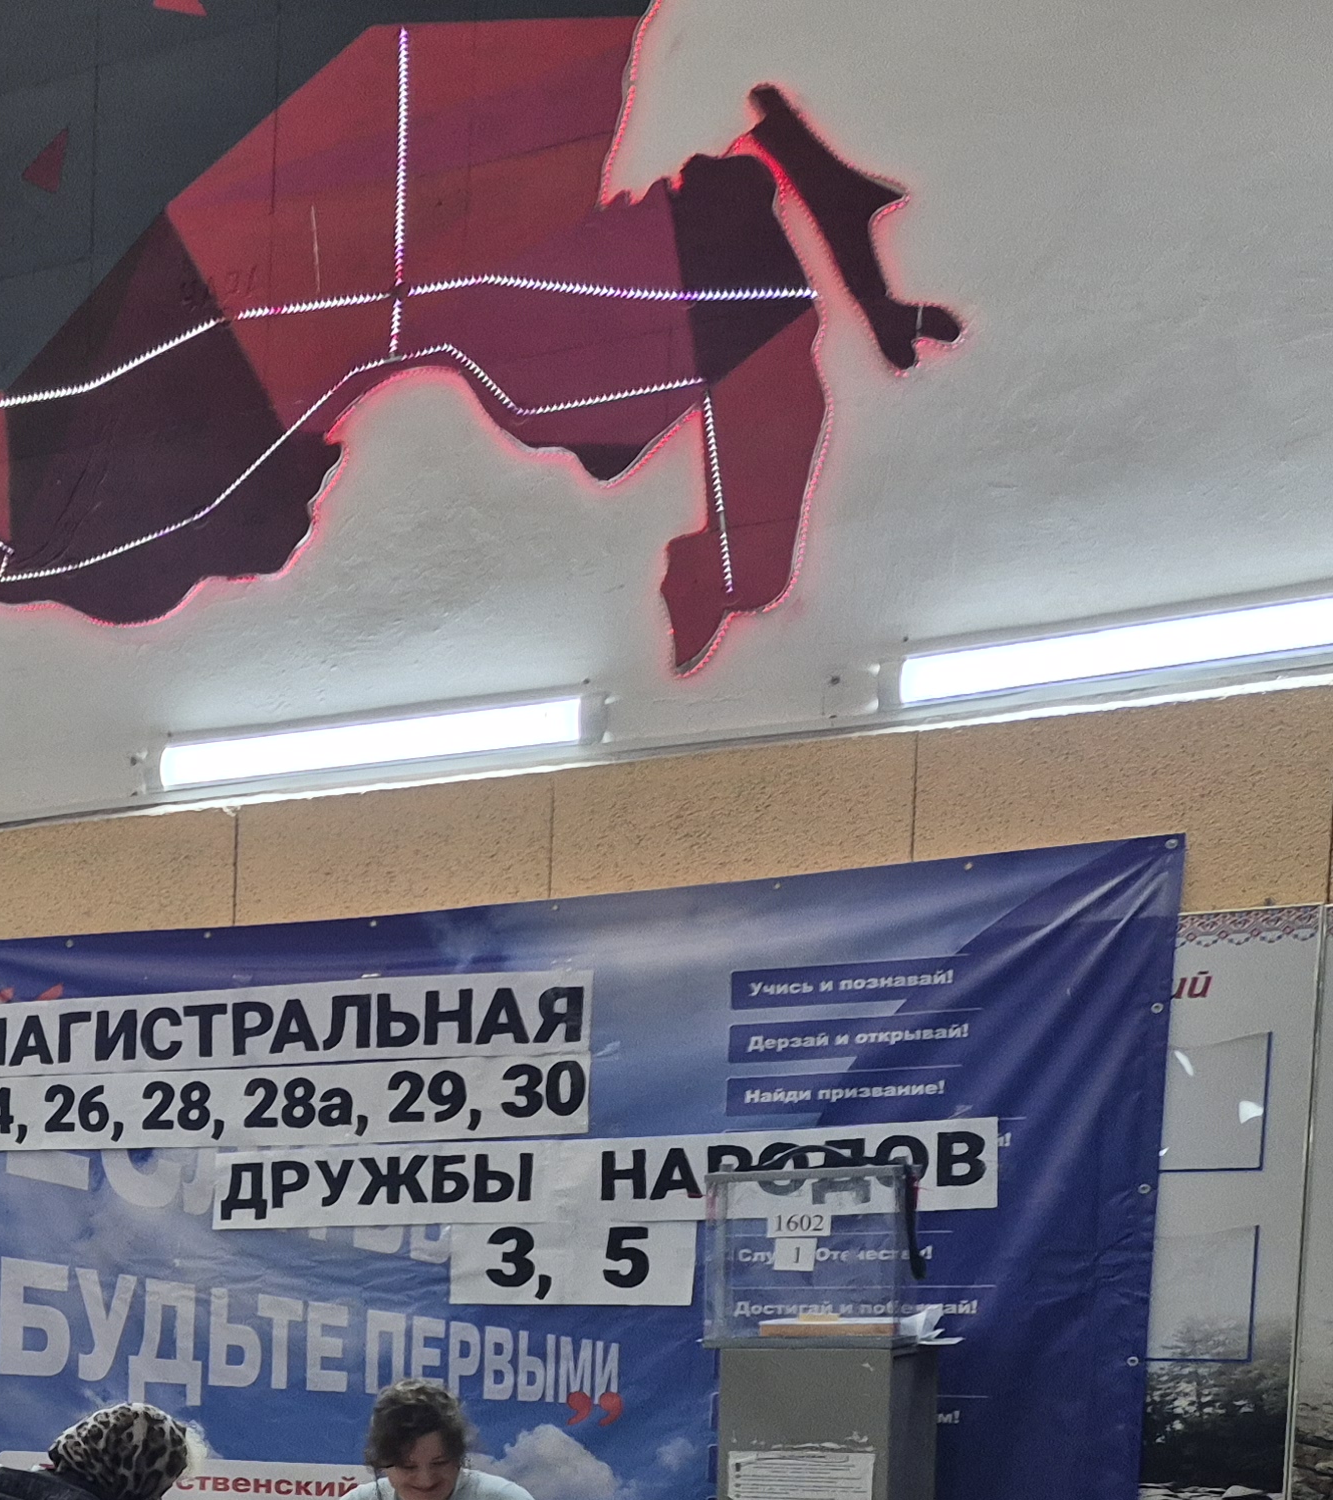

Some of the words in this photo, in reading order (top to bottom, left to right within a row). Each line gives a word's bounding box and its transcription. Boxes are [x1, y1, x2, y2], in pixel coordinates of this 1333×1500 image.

[749, 981, 813, 997] Учись
[820, 980, 833, 992] и
[839, 969, 954, 990] познавай!
[747, 1032, 829, 1052] Дерзай
[835, 1034, 848, 1046] и
[855, 1023, 970, 1045] открывай!
[44, 1084, 124, 1142] 26,
[142, 1081, 225, 1140] 28,
[244, 1077, 368, 1136] 28а,
[387, 1070, 481, 1131] 29,
[501, 1060, 586, 1118] 30
[744, 1088, 812, 1104] Найди
[818, 1080, 945, 1103] призвание!
[221, 1153, 534, 1220] ДРУЖБЫ
[601, 1131, 986, 1204] НАРОДОВ
[774, 1214, 824, 1232] 1602
[486, 1226, 552, 1300] 3,
[603, 1226, 649, 1288] 5
[739, 1248, 775, 1262] Слу
[793, 1246, 801, 1263] 1
[733, 1301, 833, 1317] Достигай
[840, 1304, 853, 1315] и
[365, 1309, 620, 1405] ПЕРВЫМИ
